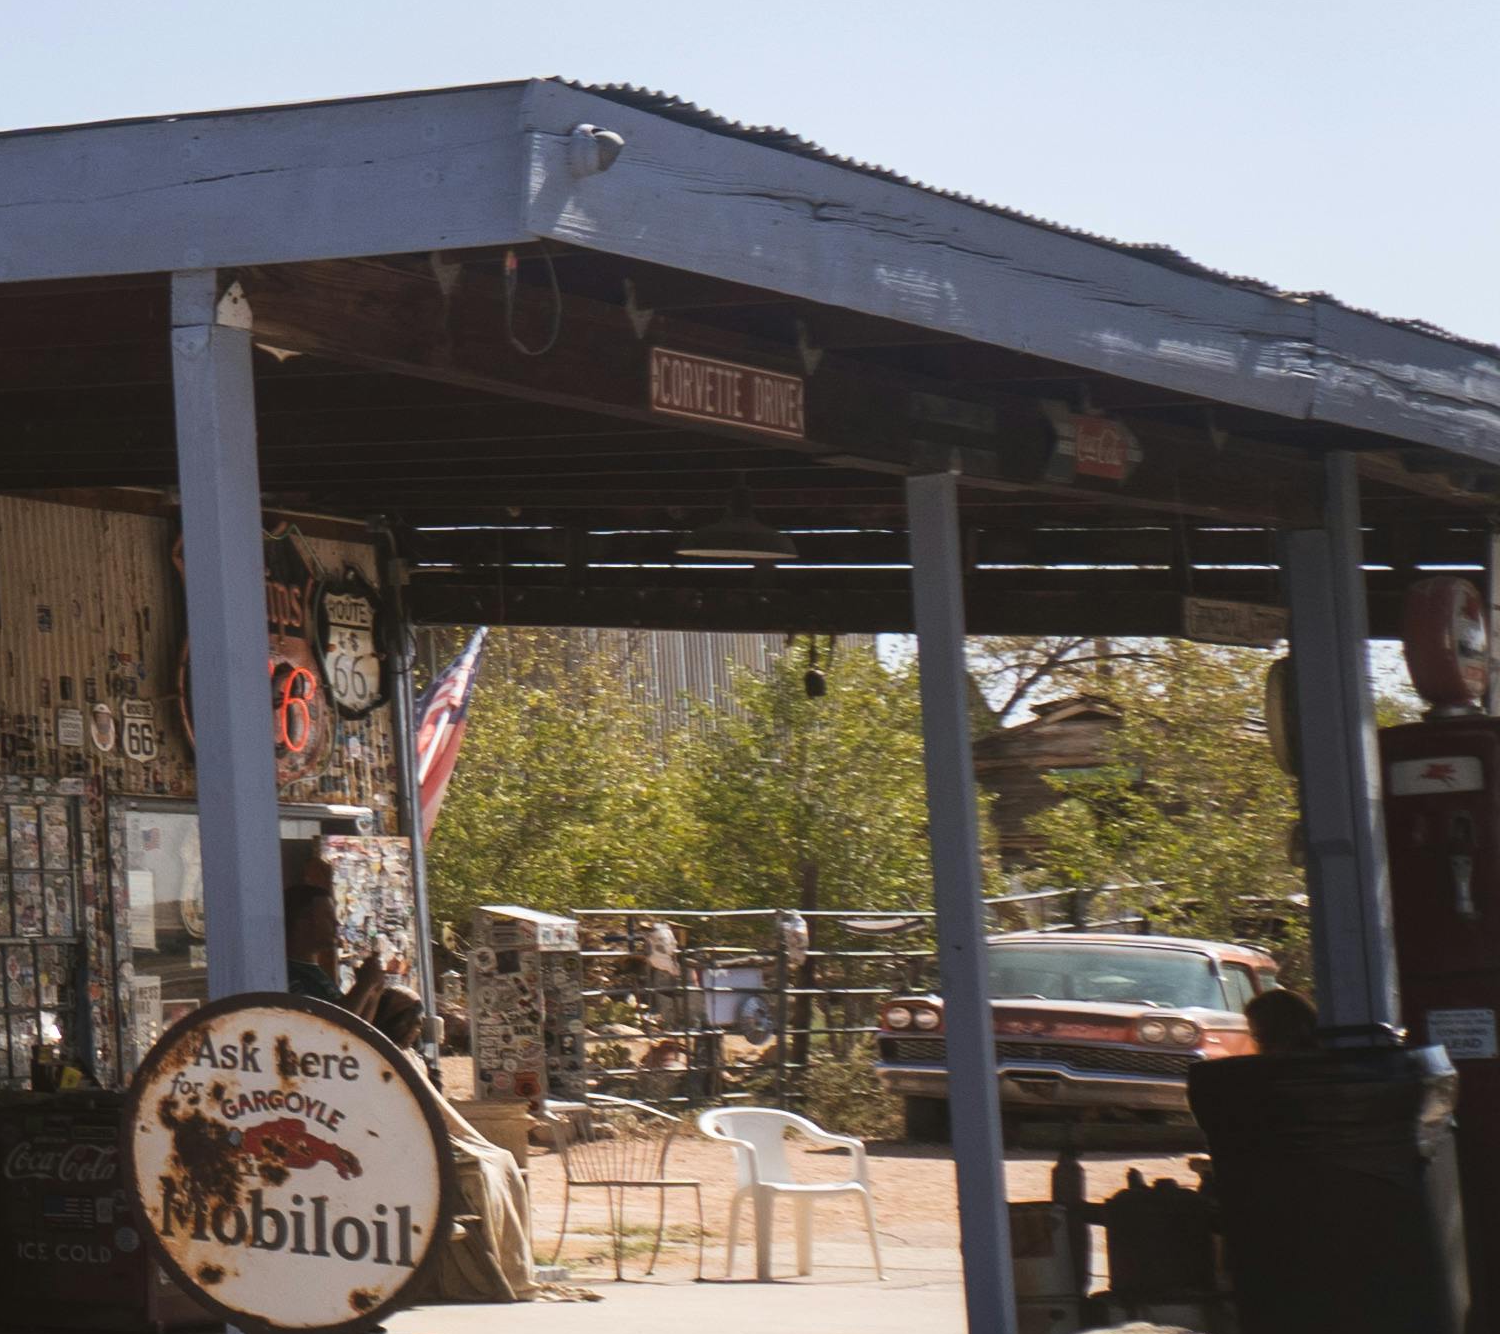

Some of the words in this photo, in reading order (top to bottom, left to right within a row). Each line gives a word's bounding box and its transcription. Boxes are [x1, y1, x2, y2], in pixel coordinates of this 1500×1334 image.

[660, 356, 743, 419] CORVETTE
[328, 597, 370, 624] ROUTE
[334, 657, 367, 699] 66
[129, 723, 155, 755] 66
[196, 1035, 262, 1073] Ask
[169, 1072, 203, 1098] for
[221, 1089, 347, 1133] GARGOYLE
[4, 1141, 120, 1182] Coca-Cola
[160, 1175, 416, 1268] Mobiloil
[16, 1242, 49, 1260] ICE
[55, 1243, 113, 1263] COLD
